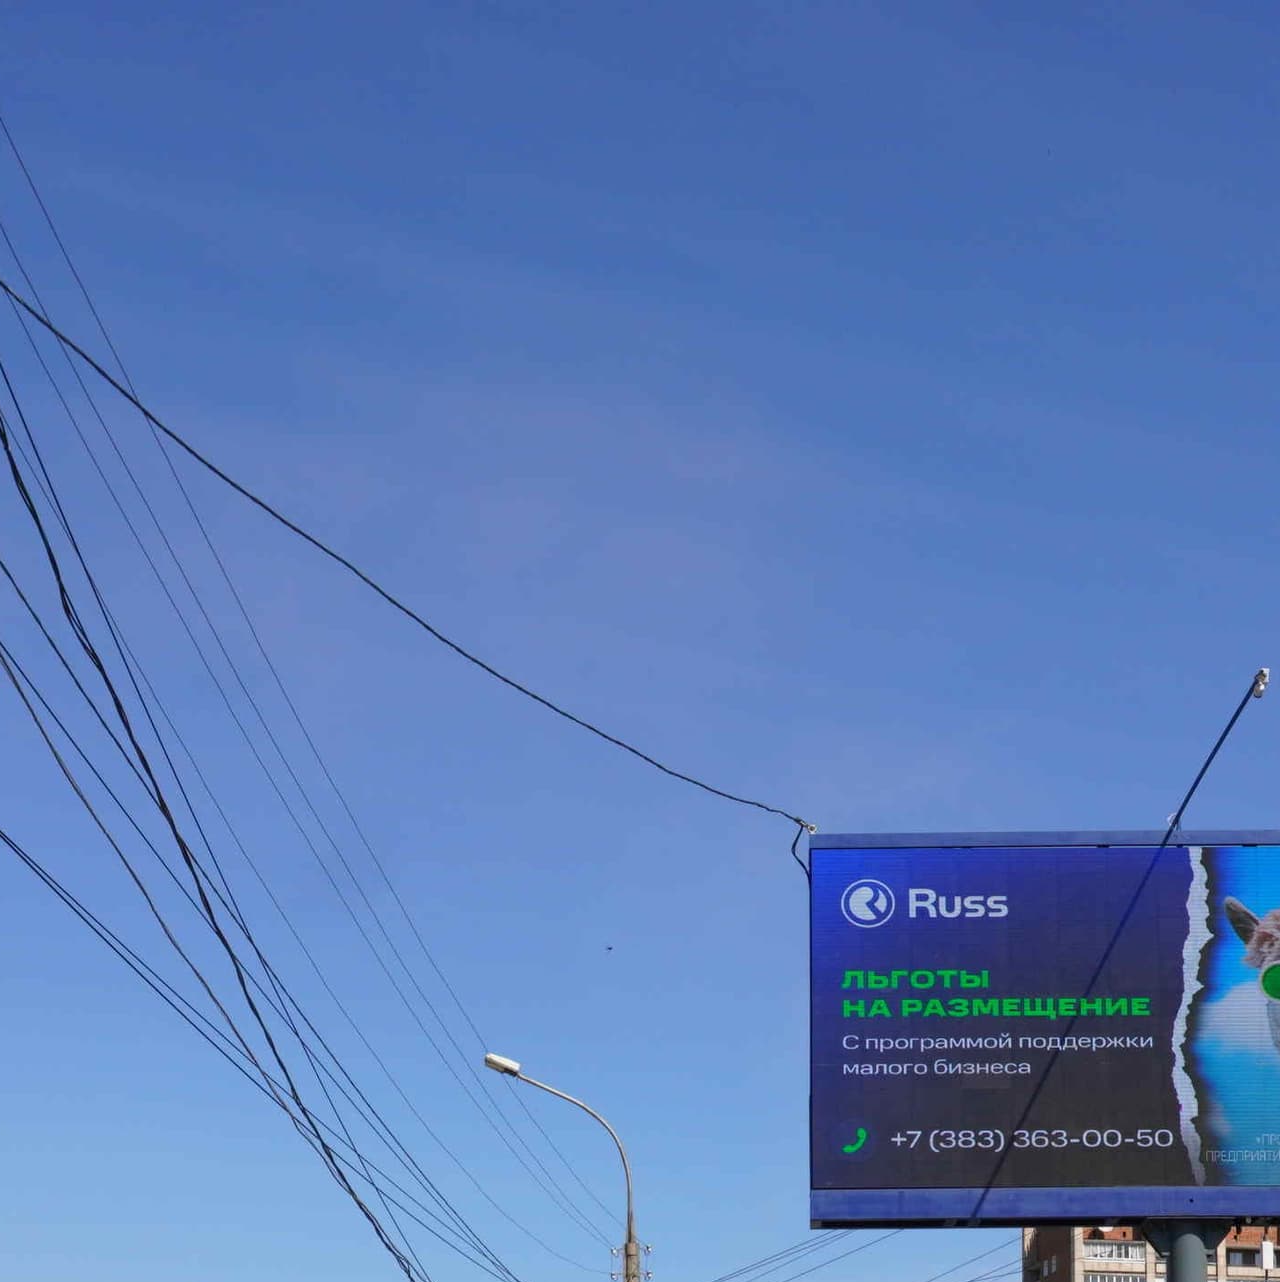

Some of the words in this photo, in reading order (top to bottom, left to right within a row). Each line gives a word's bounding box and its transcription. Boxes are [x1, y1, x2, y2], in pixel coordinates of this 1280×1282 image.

[908, 887, 1009, 919] Russ
[841, 970, 989, 990] ЛЬГОТЫ
[842, 999, 892, 1018] НА
[902, 997, 1152, 1020] РАЗМЕЩЕНИЕ
[842, 1034, 860, 1051] С
[865, 1032, 1013, 1054] программой
[1019, 1034, 1153, 1052] поддержки
[842, 1062, 928, 1076] малого
[933, 1059, 1031, 1076] бизнеса
[890, 1129, 922, 1150] +7
[929, 1128, 1005, 1153] (383)
[1013, 1128, 1174, 1149] 363-00-50
